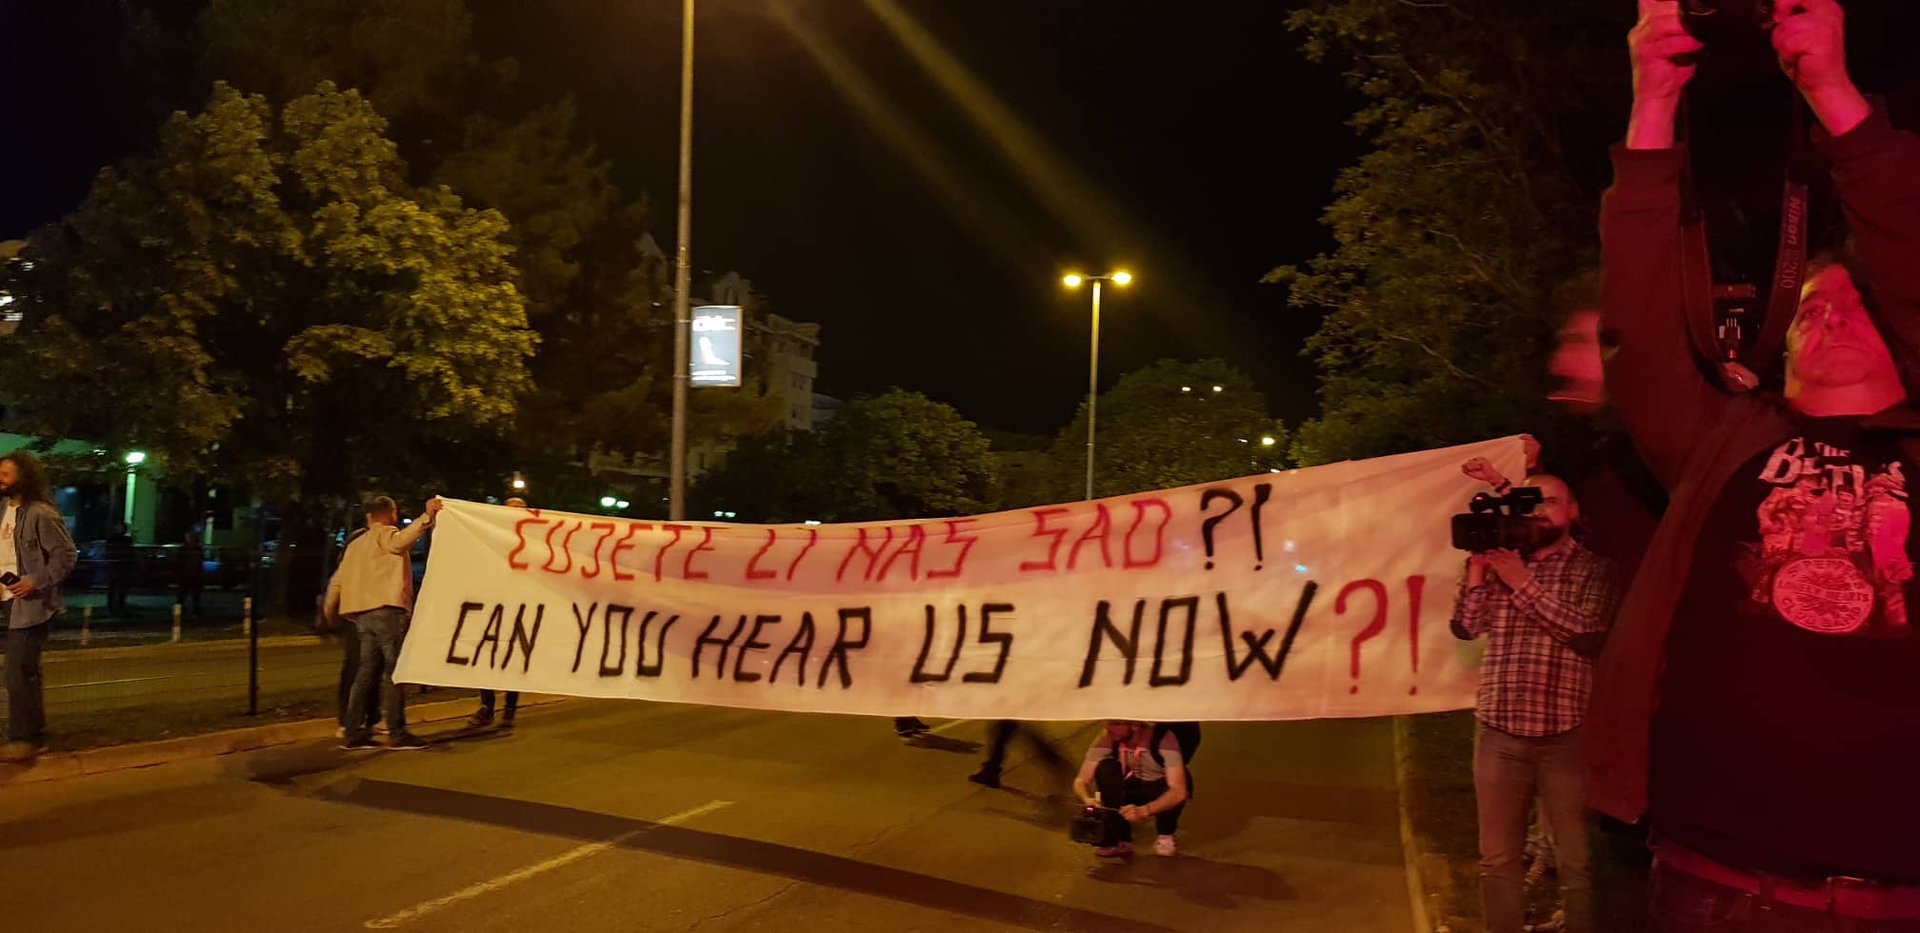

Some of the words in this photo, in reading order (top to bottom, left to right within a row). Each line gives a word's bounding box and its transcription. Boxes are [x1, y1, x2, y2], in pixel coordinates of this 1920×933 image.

[1787, 196, 1801, 245] Nikon
[836, 518, 978, 583] NAS
[1019, 498, 1172, 572] SAD
[446, 602, 545, 674] CAN
[572, 602, 680, 678] YOU
[691, 606, 872, 689] HEAR
[910, 602, 1015, 684] US
[1078, 580, 1318, 689] NOW
